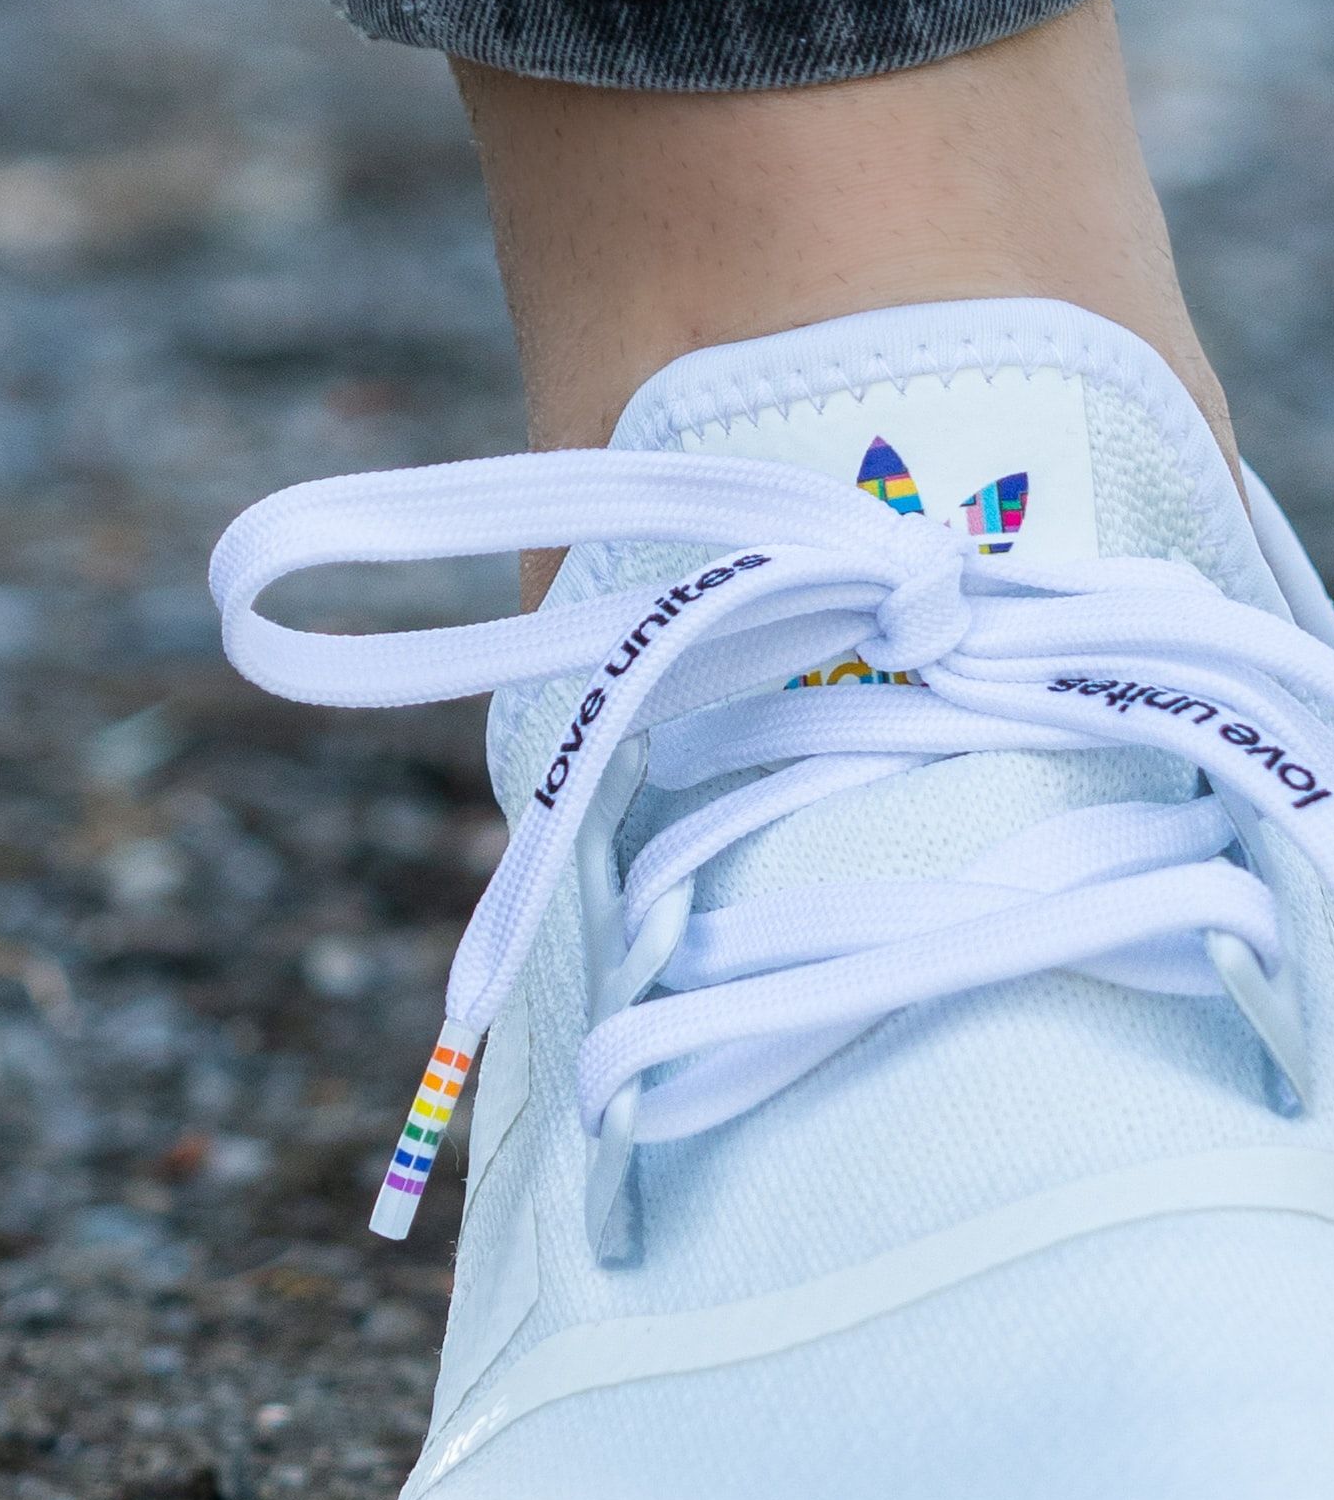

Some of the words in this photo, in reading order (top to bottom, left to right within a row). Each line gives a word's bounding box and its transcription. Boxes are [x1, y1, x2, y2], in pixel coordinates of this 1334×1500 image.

[534, 687, 607, 810] love
[604, 553, 772, 678] unites
[1046, 677, 1219, 725] unites
[1218, 722, 1333, 809] love
